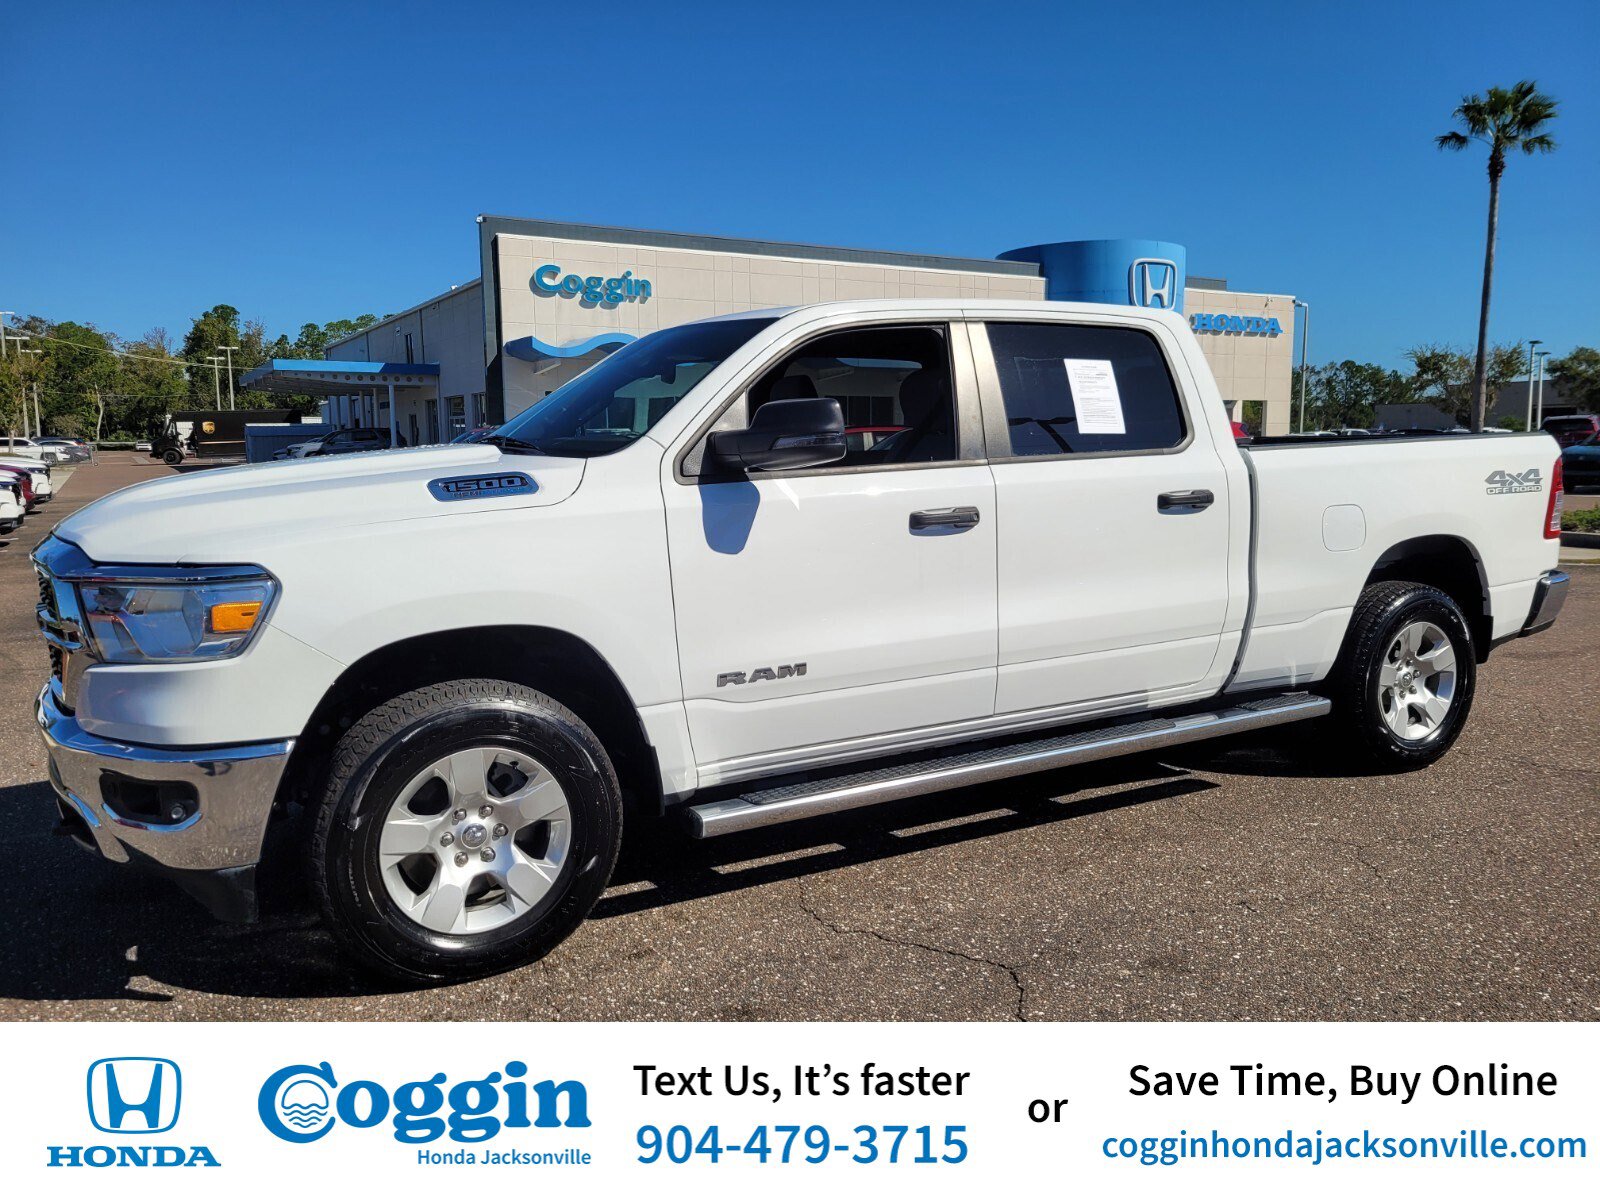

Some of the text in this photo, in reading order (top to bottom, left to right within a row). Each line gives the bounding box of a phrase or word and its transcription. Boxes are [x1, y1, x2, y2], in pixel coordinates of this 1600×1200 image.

[533, 264, 652, 303] Coggin
[1193, 313, 1283, 334] HONDA
[444, 477, 523, 491] 1500
[1485, 469, 1543, 486] 4x4
[1486, 485, 1542, 495] OFF ROAD
[716, 662, 807, 688] RAM
